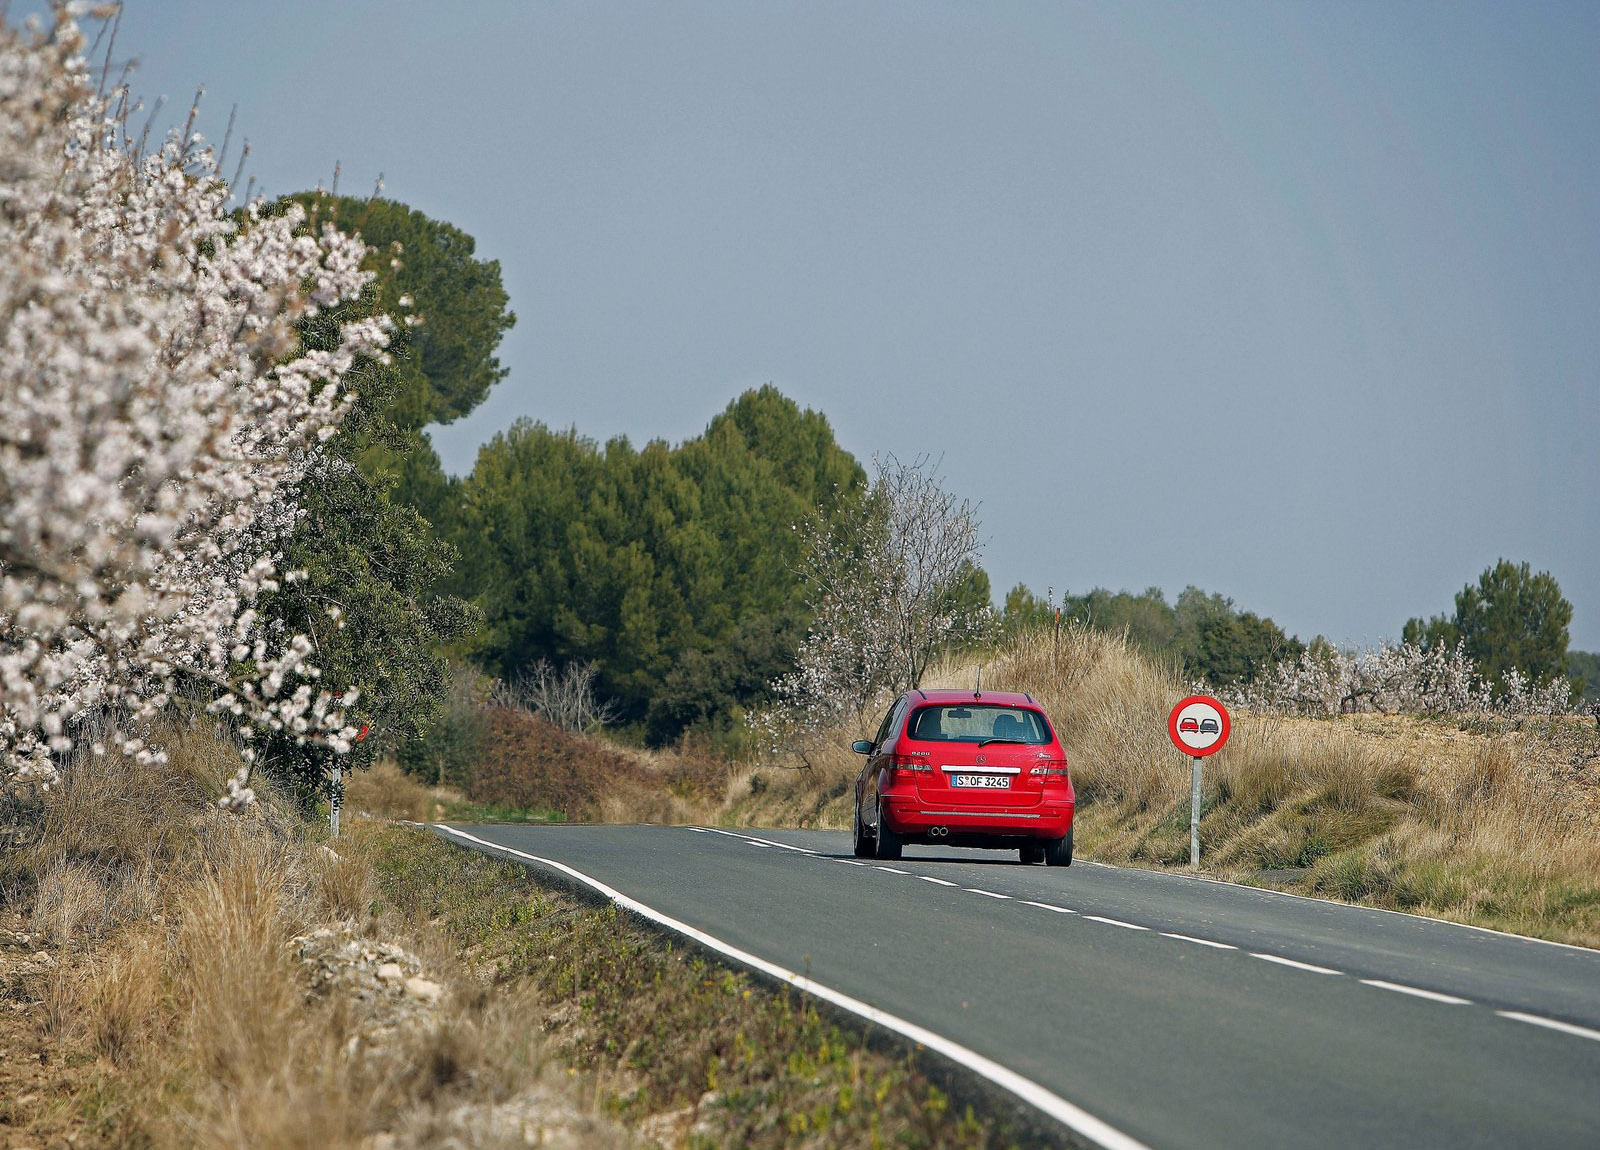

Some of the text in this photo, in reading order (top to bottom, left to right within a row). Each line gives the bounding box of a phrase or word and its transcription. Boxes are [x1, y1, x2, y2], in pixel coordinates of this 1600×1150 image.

[957, 776, 1009, 788] S OF 3245
